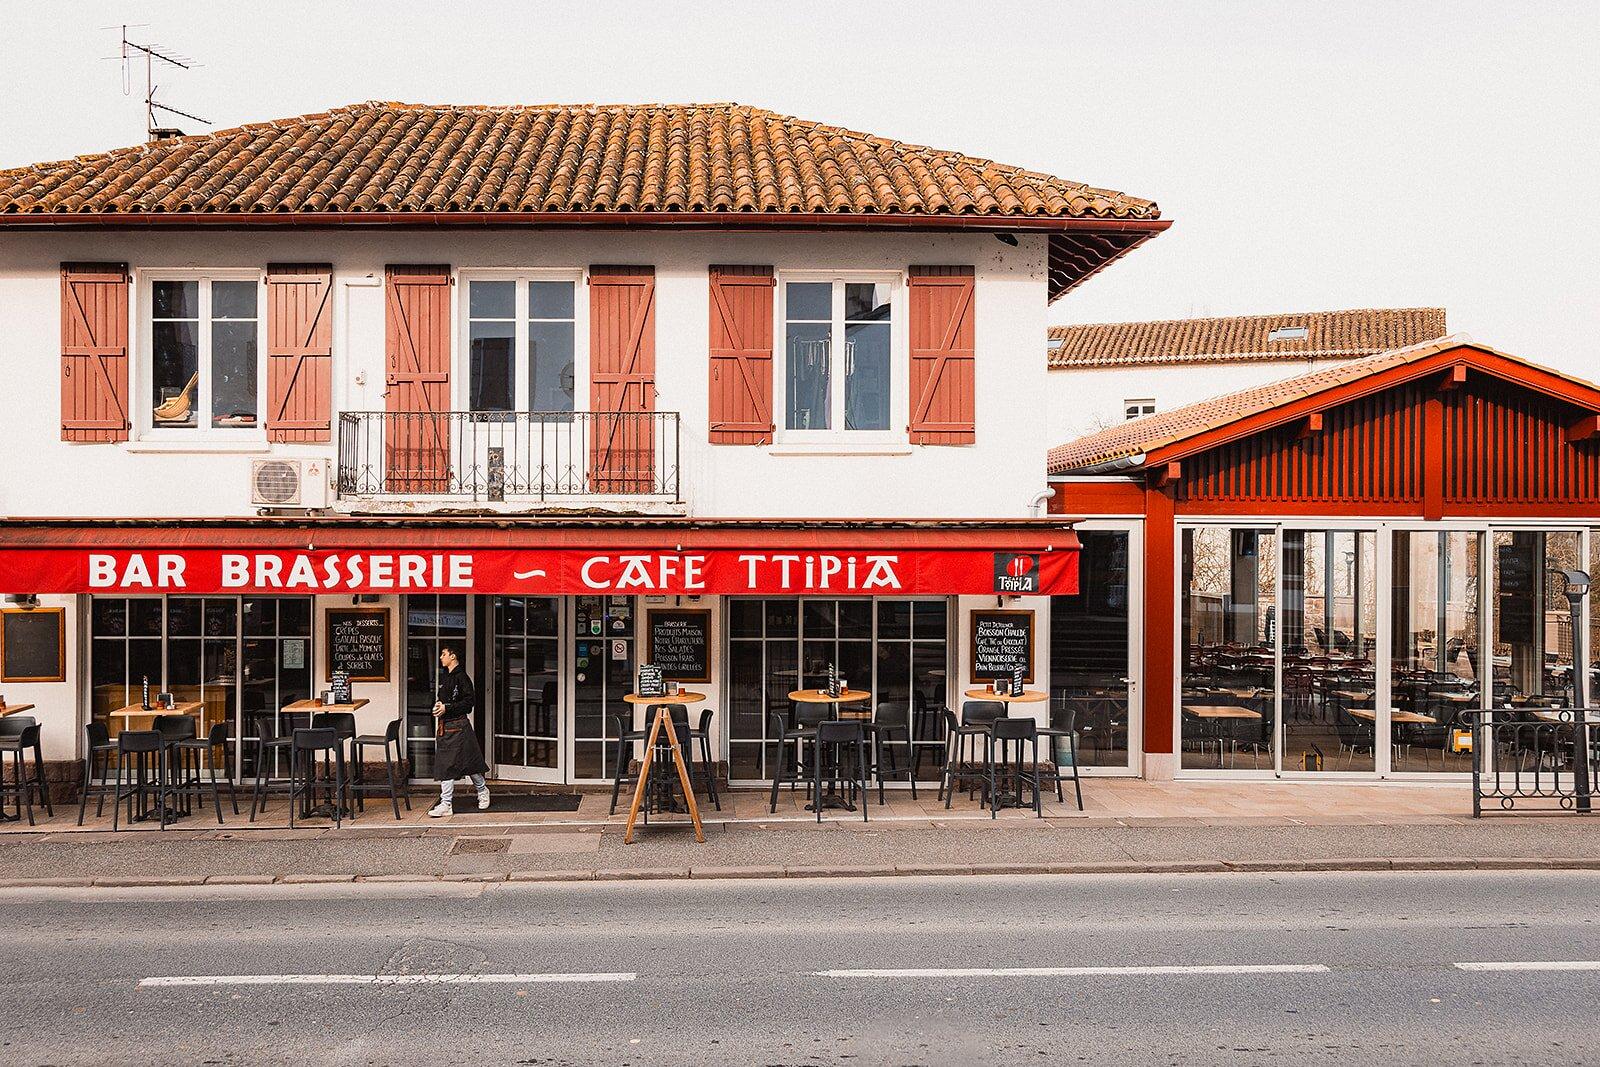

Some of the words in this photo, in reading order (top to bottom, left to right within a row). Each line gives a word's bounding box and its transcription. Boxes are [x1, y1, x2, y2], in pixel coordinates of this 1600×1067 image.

[88, 554, 187, 588] BAR
[221, 554, 475, 588] BRASSERIE
[581, 554, 706, 589] CAFE
[978, 628, 1004, 636] BOISSON
[359, 644, 383, 652] MOMENT
[668, 644, 694, 654] SALADES
[346, 662, 372, 670] SORBETS
